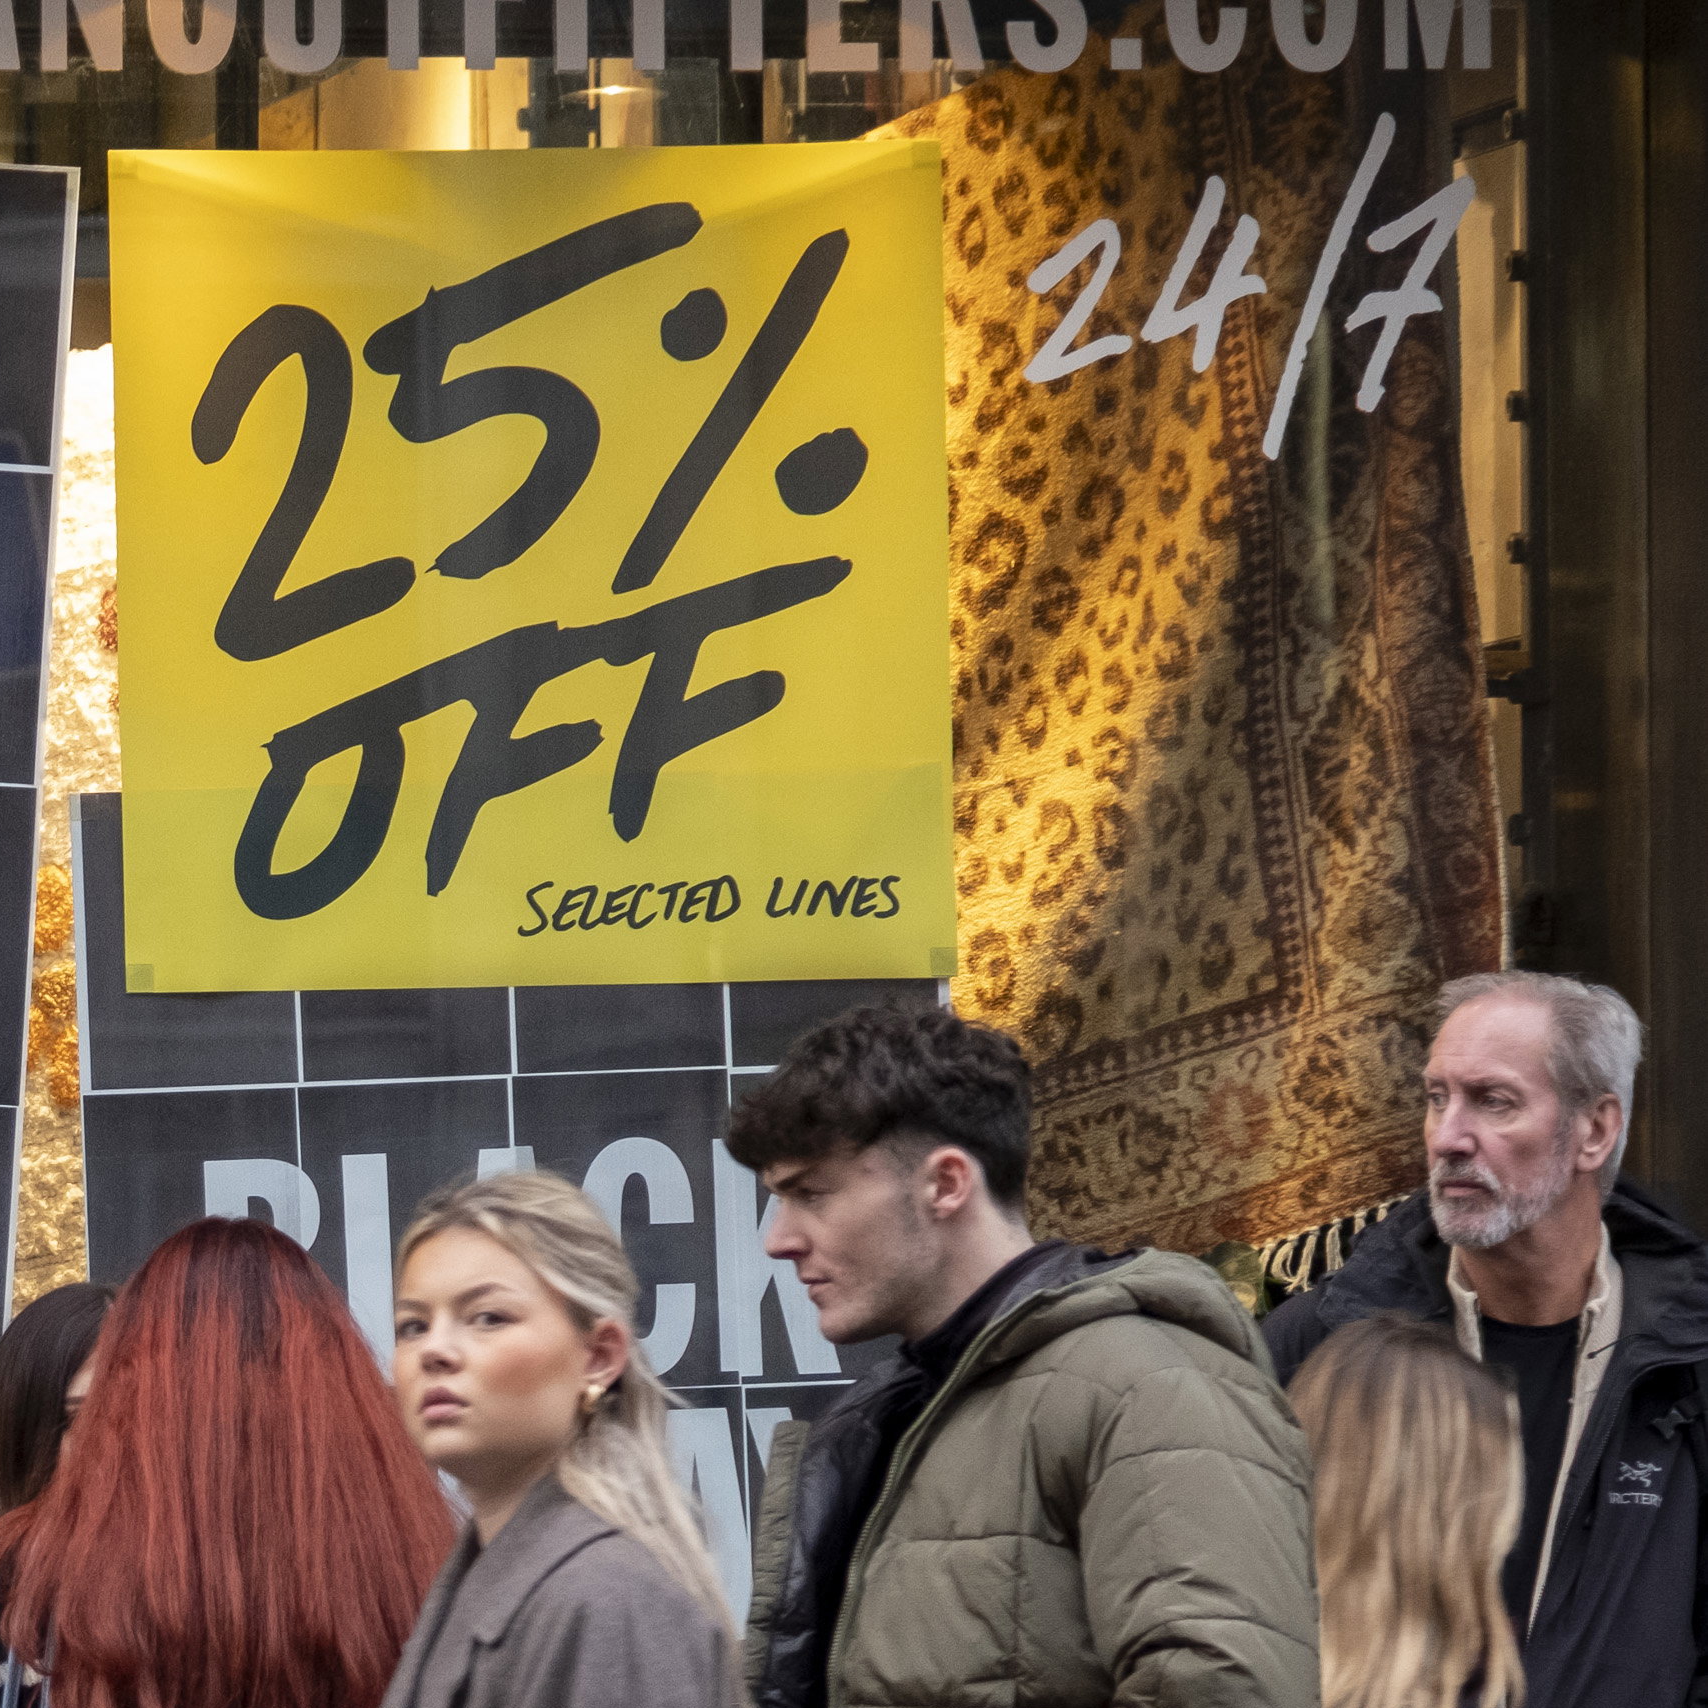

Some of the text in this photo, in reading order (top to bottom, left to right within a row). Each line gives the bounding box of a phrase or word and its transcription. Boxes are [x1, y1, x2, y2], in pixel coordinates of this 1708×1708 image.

[191, 201, 869, 662] 25%
[1023, 110, 1477, 461] 24/7
[234, 555, 854, 921] OFF
[516, 874, 902, 937] SELECTED LINES
